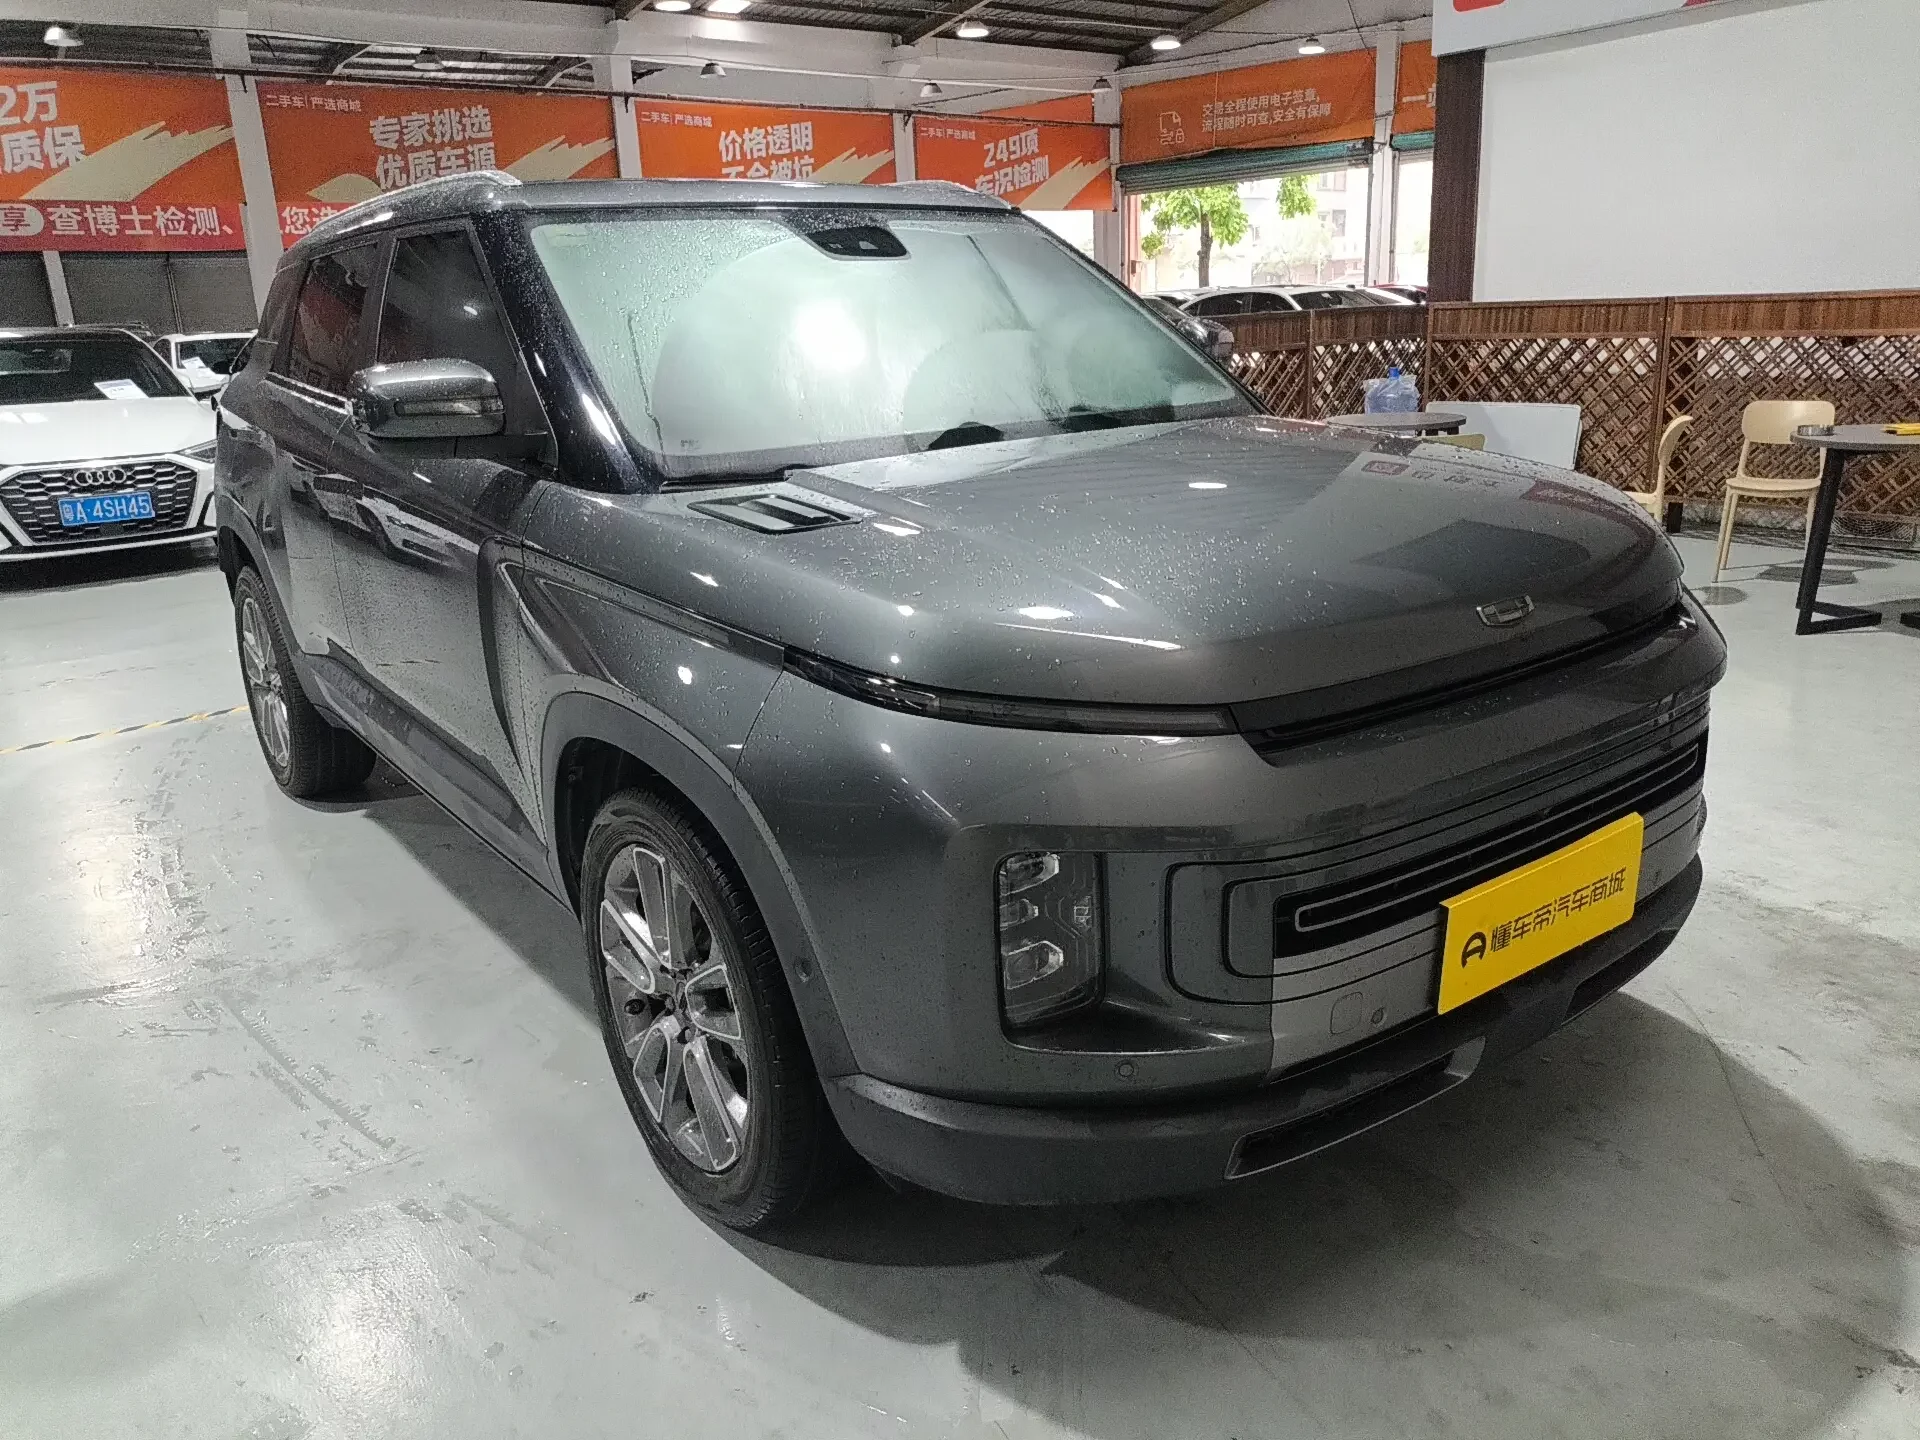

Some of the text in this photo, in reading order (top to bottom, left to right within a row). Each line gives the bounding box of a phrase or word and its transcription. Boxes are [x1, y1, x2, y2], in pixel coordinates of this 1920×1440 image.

[369, 105, 493, 149] 专家挑选
[719, 121, 813, 162] 价格透明
[984, 128, 1039, 168] 249项
[1, 124, 87, 174] 质保
[376, 142, 497, 190] 优质车源
[975, 155, 1049, 196] 车况检测
